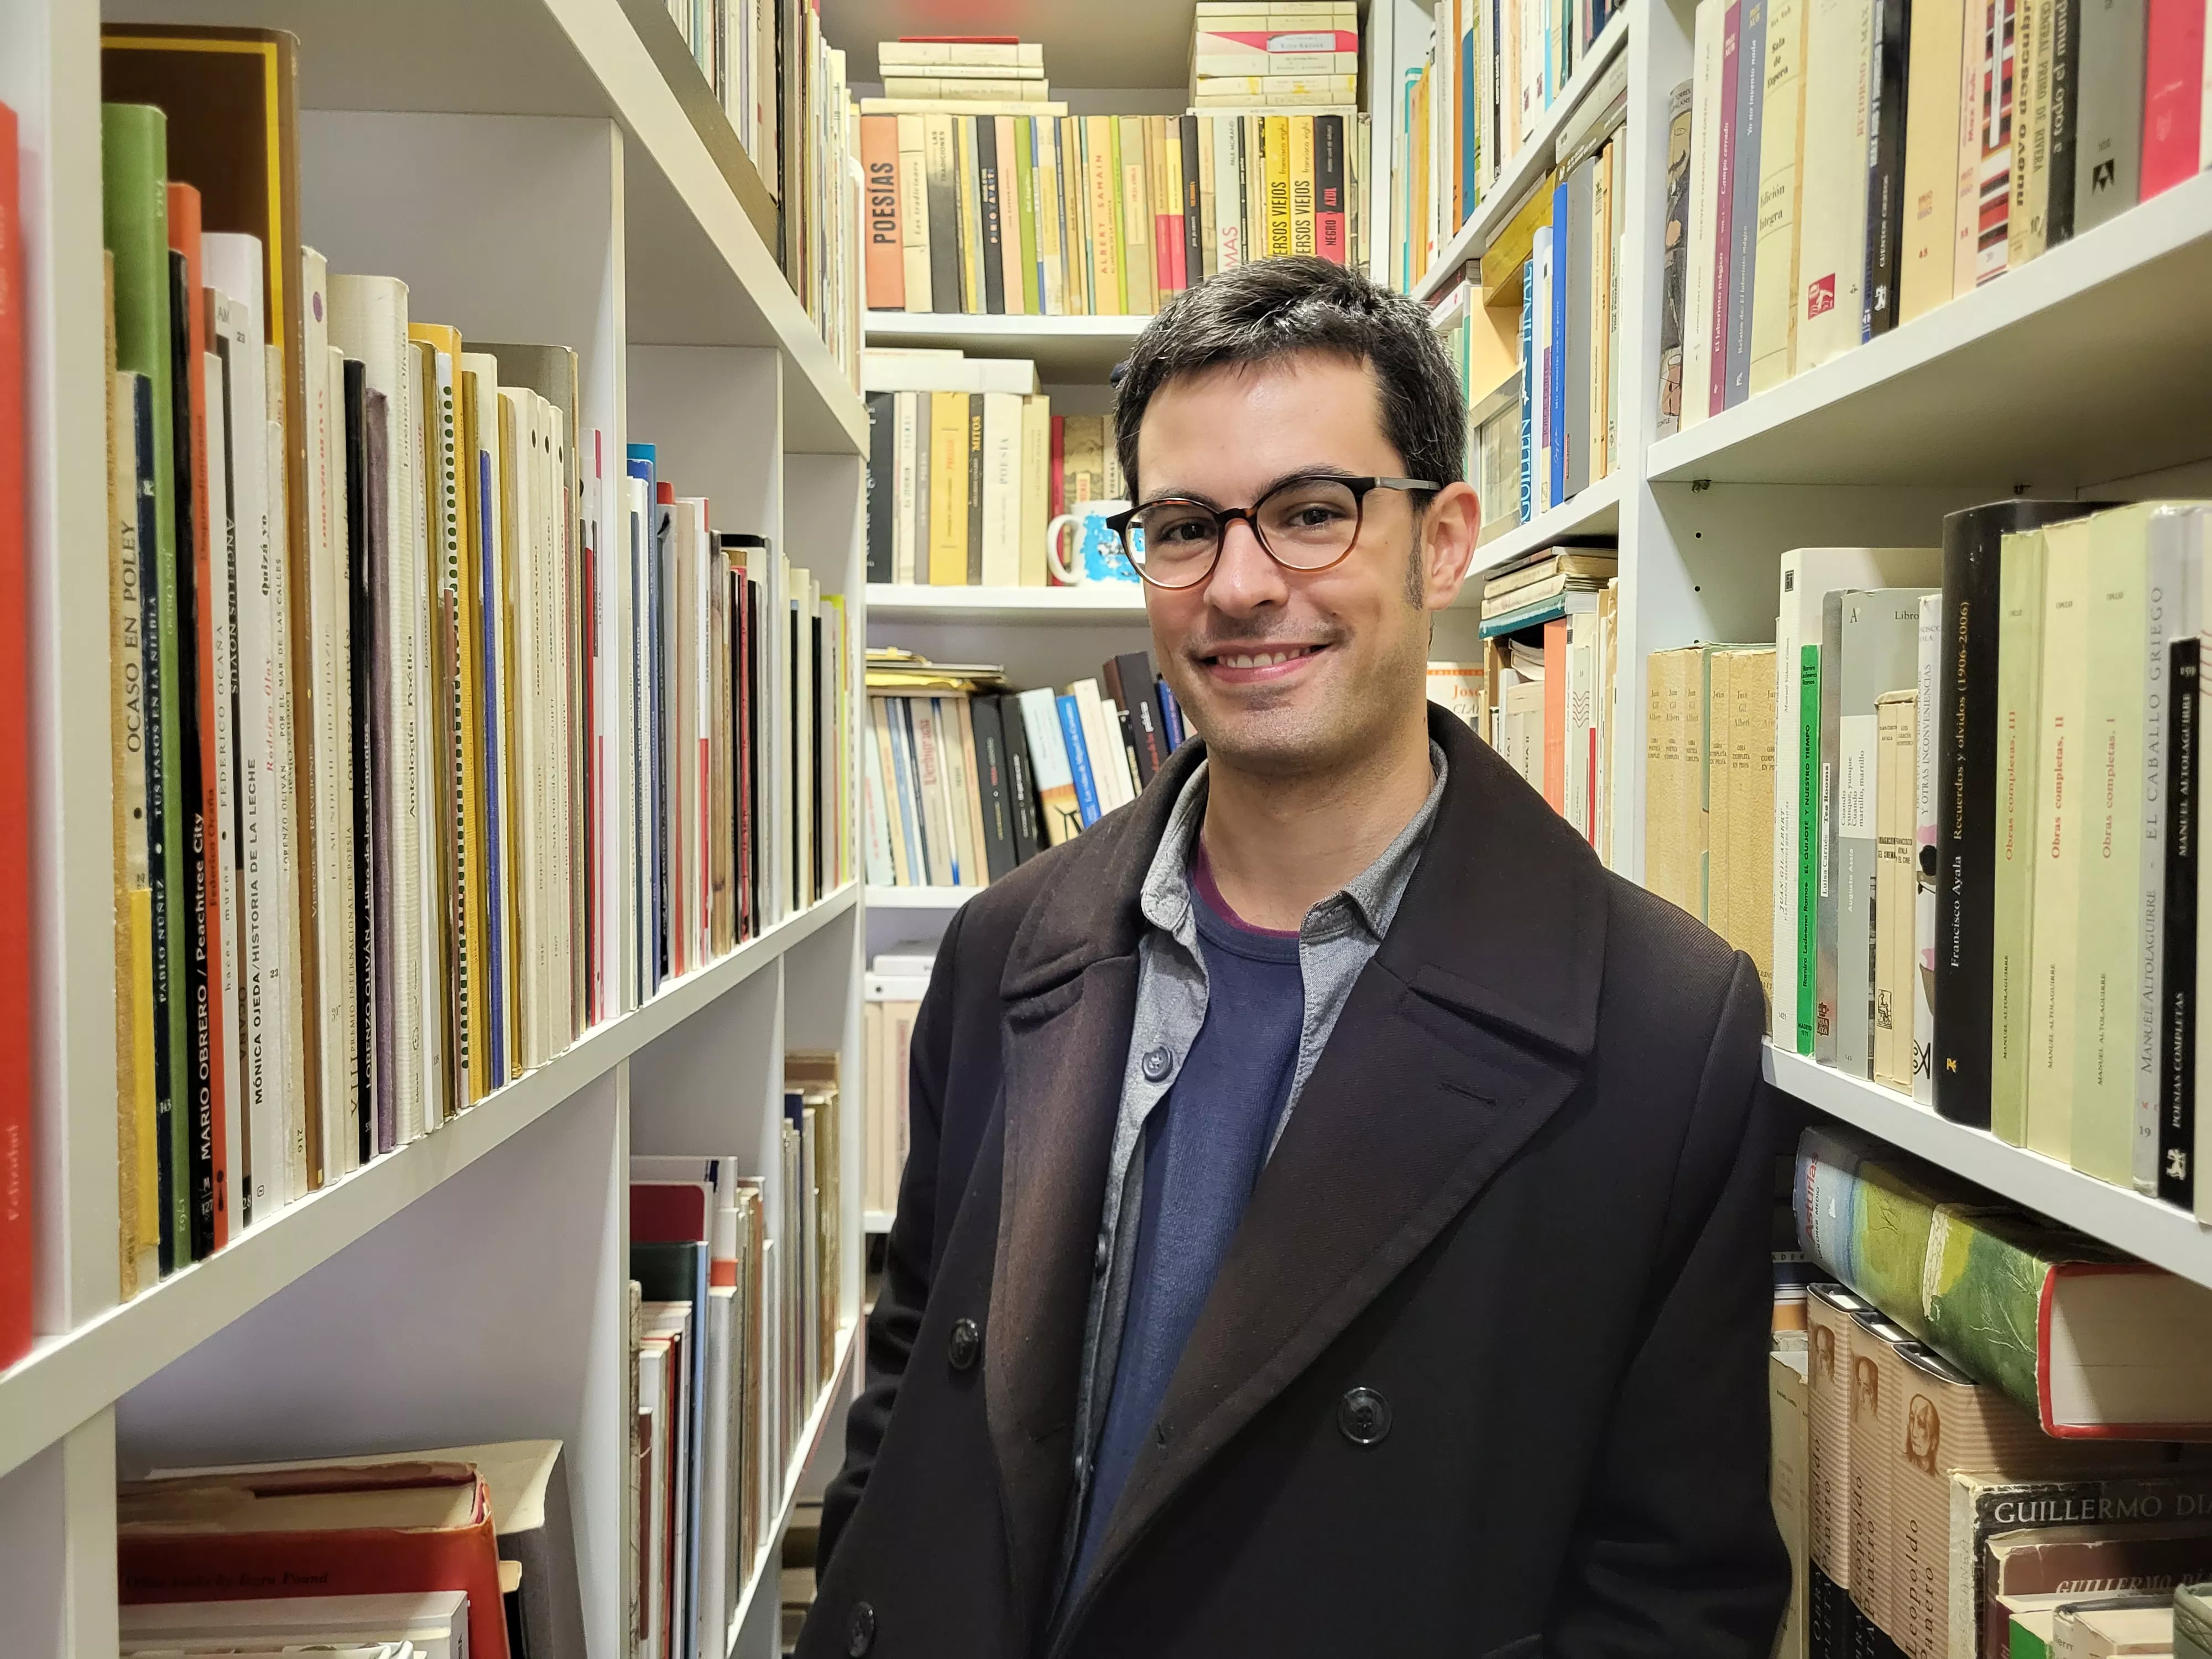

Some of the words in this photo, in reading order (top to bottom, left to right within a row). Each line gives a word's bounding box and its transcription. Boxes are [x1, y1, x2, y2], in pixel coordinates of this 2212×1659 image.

[1772, 38, 1785, 53] Sala
[1773, 55, 1781, 66] de
[1767, 66, 1788, 88] Espera
[2052, 61, 2065, 80] el
[1747, 122, 1752, 135] Yo
[1749, 107, 1754, 121] no
[2051, 87, 2065, 135] todo
[2016, 123, 2027, 206] nuevo
[2033, 127, 2046, 172] RIVERA
[2053, 143, 2063, 153] a
[868, 161, 896, 243] POESÍAS
[1095, 154, 1105, 207] SAMAIN
[1271, 181, 1287, 216] VIEJOS
[1294, 180, 1311, 215] VIEJOS
[1098, 221, 1108, 274] ALBERT
[1271, 221, 1288, 255] ERSOS
[1295, 219, 1311, 254] ERSOS
[1324, 220, 1337, 246] NEGRO
[1715, 340, 1720, 352] El
[971, 415, 981, 451] MITOS
[121, 520, 137, 601] POLEY
[226, 517, 237, 615] ANGELUS
[124, 615, 138, 648] EN
[149, 596, 158, 661] NIEBLA
[1958, 601, 1970, 691] (1906-2006)
[2149, 586, 2163, 680] GRIEGO
[151, 668, 159, 688] LA
[216, 624, 225, 695] OCAÑA
[230, 622, 239, 693] NOVUS
[126, 662, 142, 752] OCASO
[152, 696, 159, 717] EN
[1713, 690, 1724, 699] Juan
[1738, 690, 1747, 700] Juan
[1923, 664, 1932, 763] INCONVENIENCIAS
[1735, 718, 1750, 727] Albert
[1954, 695, 1965, 748] olvidos
[2007, 711, 2016, 730] III
[2055, 716, 2064, 728] II
[153, 724, 161, 778] PASOS
[218, 705, 227, 807] FEDERICO
[1957, 752, 1964, 761] y
[2146, 692, 2161, 802] CABALLO
[2179, 693, 2192, 794] ALTOLAGUIRRE
[248, 758, 257, 815] LECHE
[2006, 734, 2016, 813] completas,
[2054, 735, 2064, 808] completas,
[2105, 730, 2116, 808] completas,
[1953, 765, 1964, 839] Recuerdos
[194, 812, 204, 853] City
[249, 821, 257, 843] LA
[2004, 817, 2014, 860] Obras
[2051, 816, 2062, 858] Obras
[2102, 814, 2113, 858] Obras
[2145, 813, 2157, 839] EL
[2178, 800, 2189, 856] MANUEL
[249, 849, 258, 872] DE
[347, 873, 353, 890] DE
[1804, 864, 1809, 873] EL
[1952, 855, 1963, 895] Ayala
[196, 860, 206, 961] Peachtree
[1950, 900, 1960, 967] Francisco
[2142, 889, 2156, 1001] ALTOLAGUIRRE
[198, 984, 209, 1079] OBRERO
[2140, 1007, 2154, 1073] MANUEL
[2173, 992, 2184, 1071] COMPLETAS
[253, 1033, 262, 1104] MÓNICA
[200, 1087, 211, 1159] MARIO
[2140, 1125, 2151, 1137] 19
[1805, 1152, 1819, 1244] Asturias
[1994, 1496, 2163, 1524] GUILLERMO
[238, 1573, 276, 1587] Ezra
[283, 1571, 329, 1585] Pound
[1864, 1520, 1875, 1619] Panero
[1905, 1519, 1918, 1657] Leopoldo
[2055, 1575, 2173, 1593] GUILLERMO
